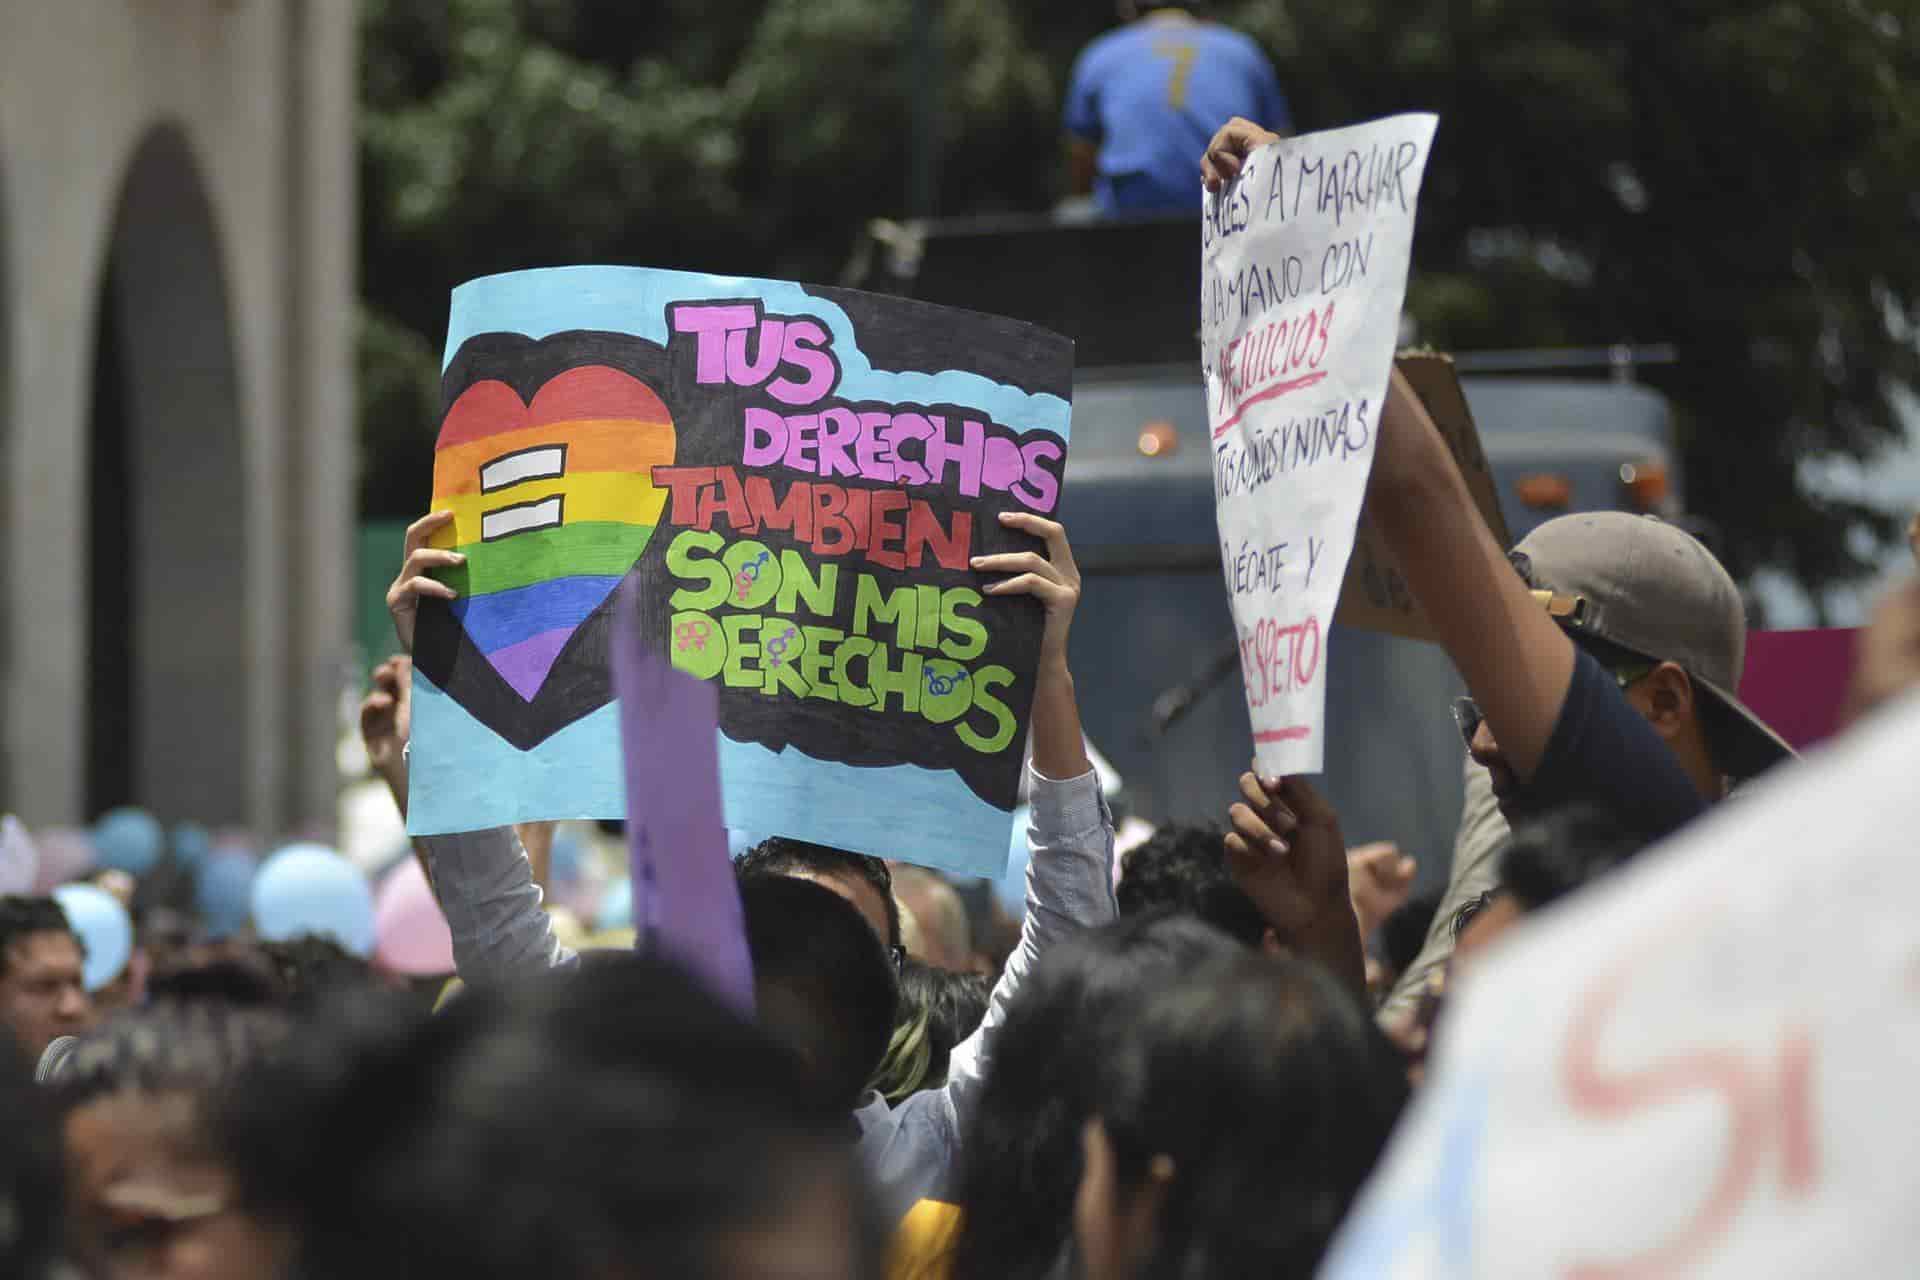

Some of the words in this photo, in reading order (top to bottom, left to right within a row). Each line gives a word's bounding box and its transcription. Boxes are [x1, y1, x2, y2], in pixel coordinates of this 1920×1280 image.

[1263, 155, 1285, 222] A
[1320, 232, 1373, 296] CON
[672, 304, 836, 405] TUS
[742, 407, 1062, 513] DERECHOS
[665, 529, 840, 617] SON
[852, 573, 989, 661] MIS
[1304, 536, 1325, 590] Y
[670, 610, 1018, 754] DERECHOS
